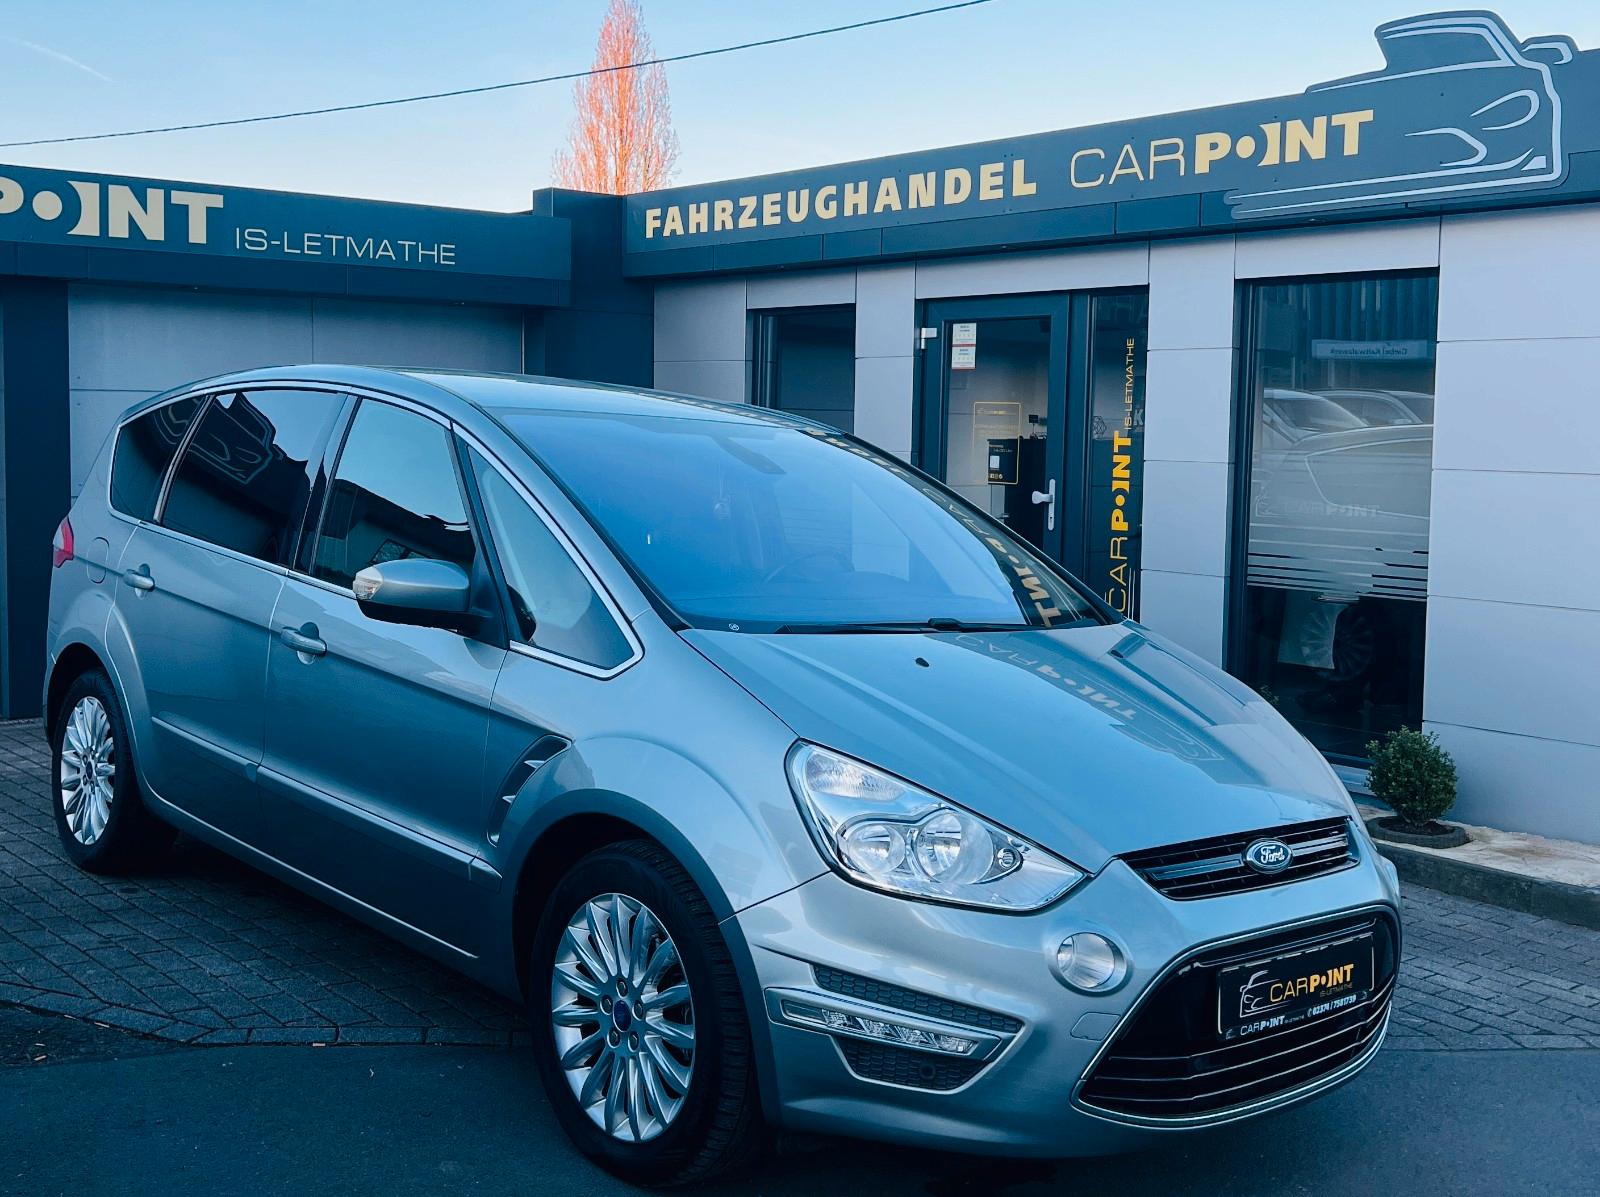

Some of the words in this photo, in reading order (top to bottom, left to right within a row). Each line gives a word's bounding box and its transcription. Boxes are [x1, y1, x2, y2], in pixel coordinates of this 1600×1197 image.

[645, 158, 1037, 239] FAHRZEUGHANDEL
[1070, 109, 1374, 189] CARPOINT
[235, 227, 457, 265] IS-LETMATHE
[1123, 337, 1135, 430] IS-LETMATHE
[1260, 845, 1286, 864] Ford
[1270, 964, 1354, 1002] CARPOINT
